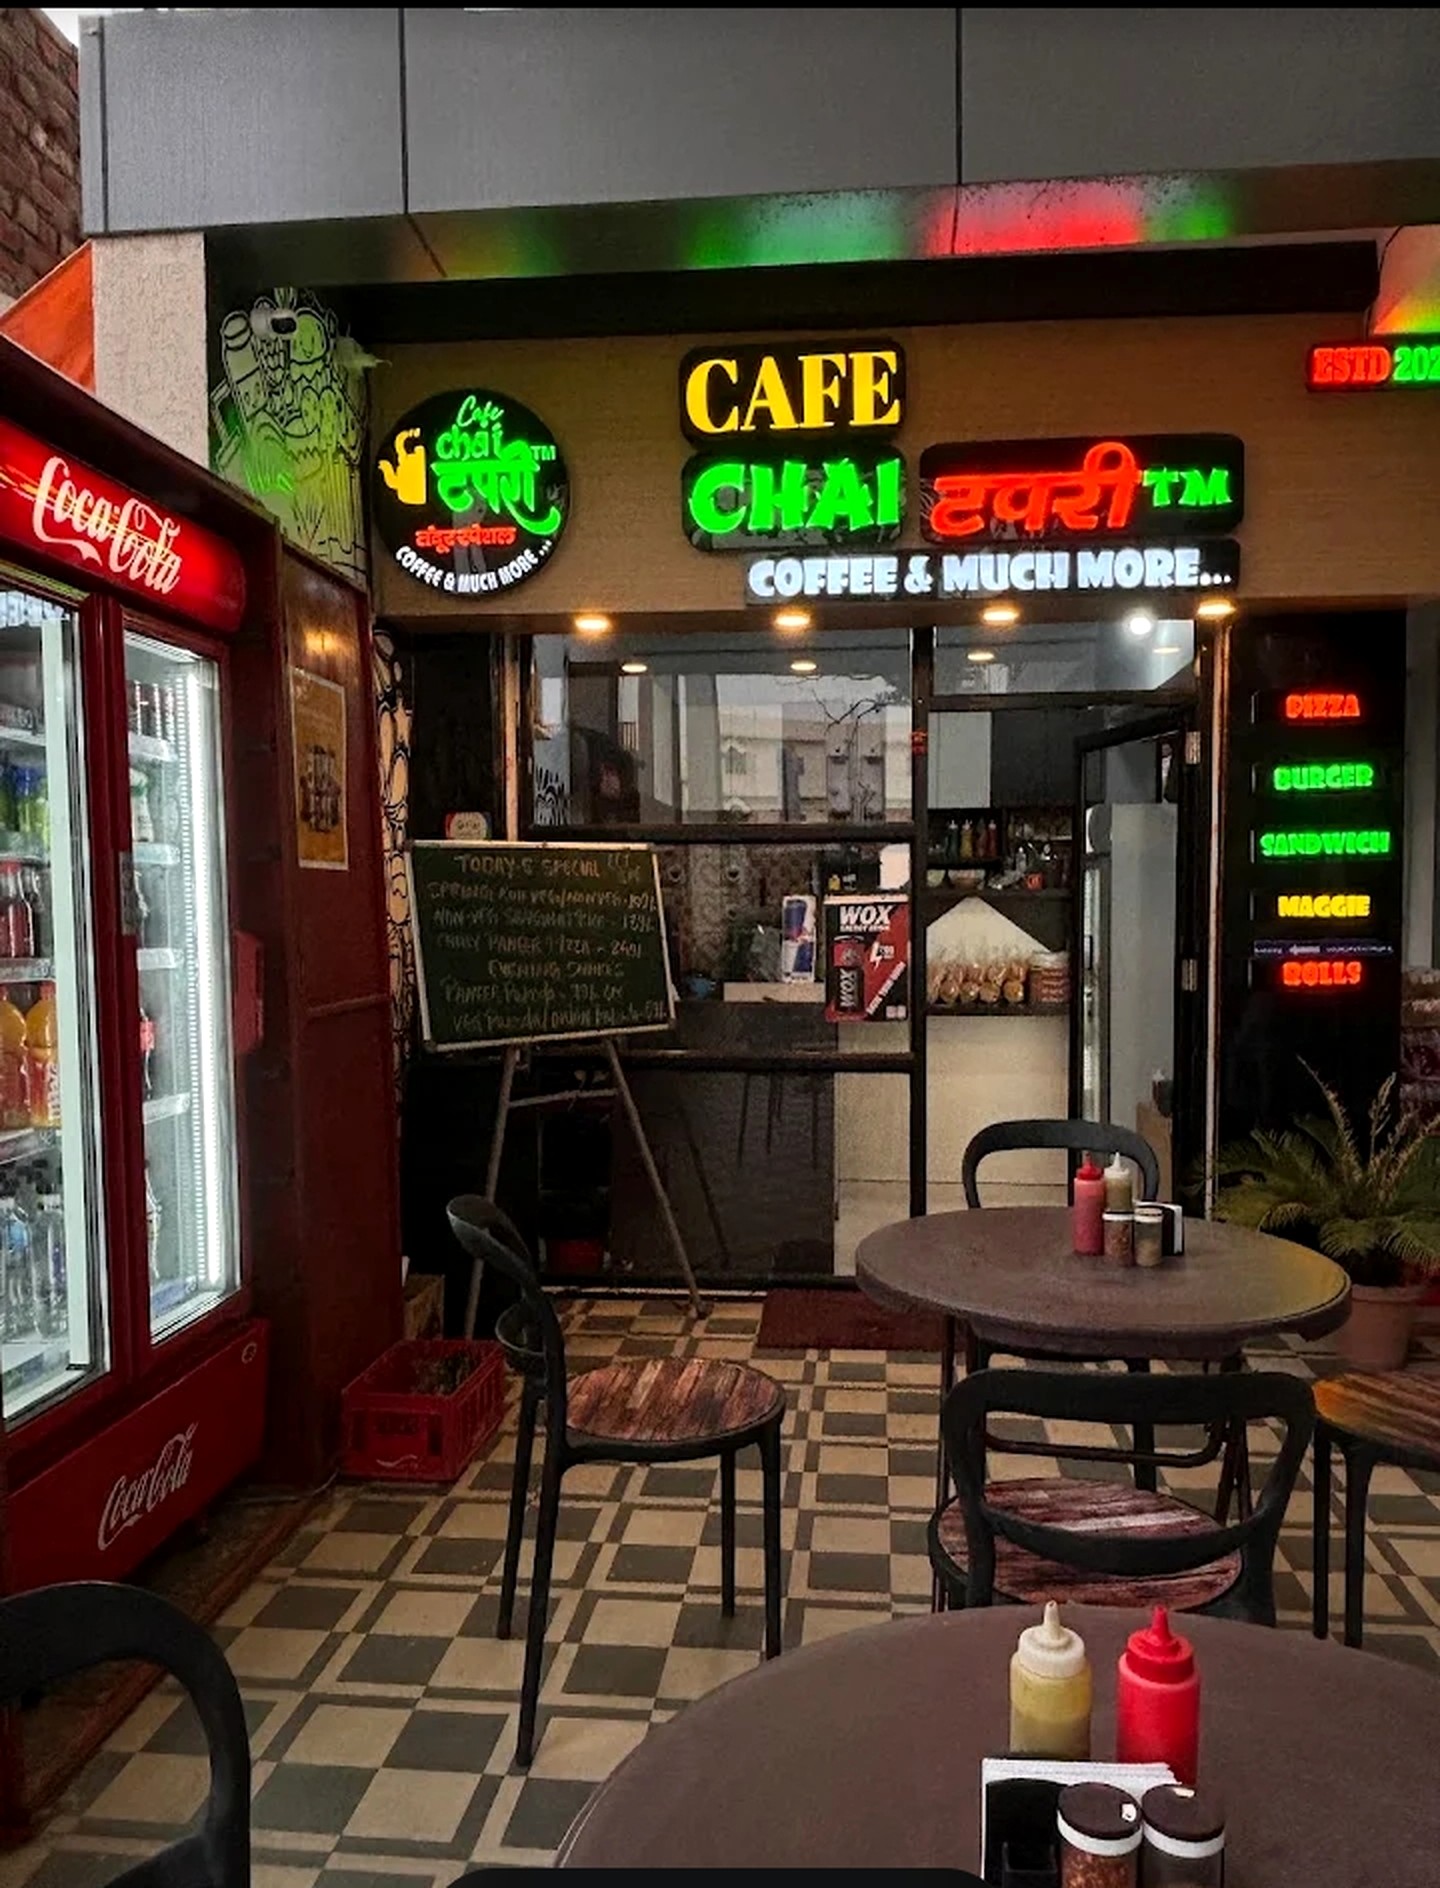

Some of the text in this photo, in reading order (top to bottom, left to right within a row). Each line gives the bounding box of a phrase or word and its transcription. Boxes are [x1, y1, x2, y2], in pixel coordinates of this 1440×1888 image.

[1313, 347, 1391, 383] ESTD
[685, 351, 900, 434] CAFE
[457, 395, 504, 428] Cafe
[430, 440, 561, 535] टपरी
[688, 457, 900, 533] CHAI
[1142, 468, 1233, 507] TM
[32, 456, 182, 595] Coca-Cola
[396, 545, 444, 587] COFFEE
[443, 572, 457, 592] &
[457, 571, 499, 593] MUCH
[748, 548, 1233, 597] COFFEE & MUCH MORE...
[1285, 694, 1361, 719] PIZZA
[1273, 765, 1374, 790] BURGER
[1260, 831, 1391, 856] SANDWICH
[839, 905, 894, 925] WOX
[1278, 895, 1371, 917] MAGGIE
[840, 970, 858, 1008] WOX
[1282, 961, 1362, 985] ROLLS
